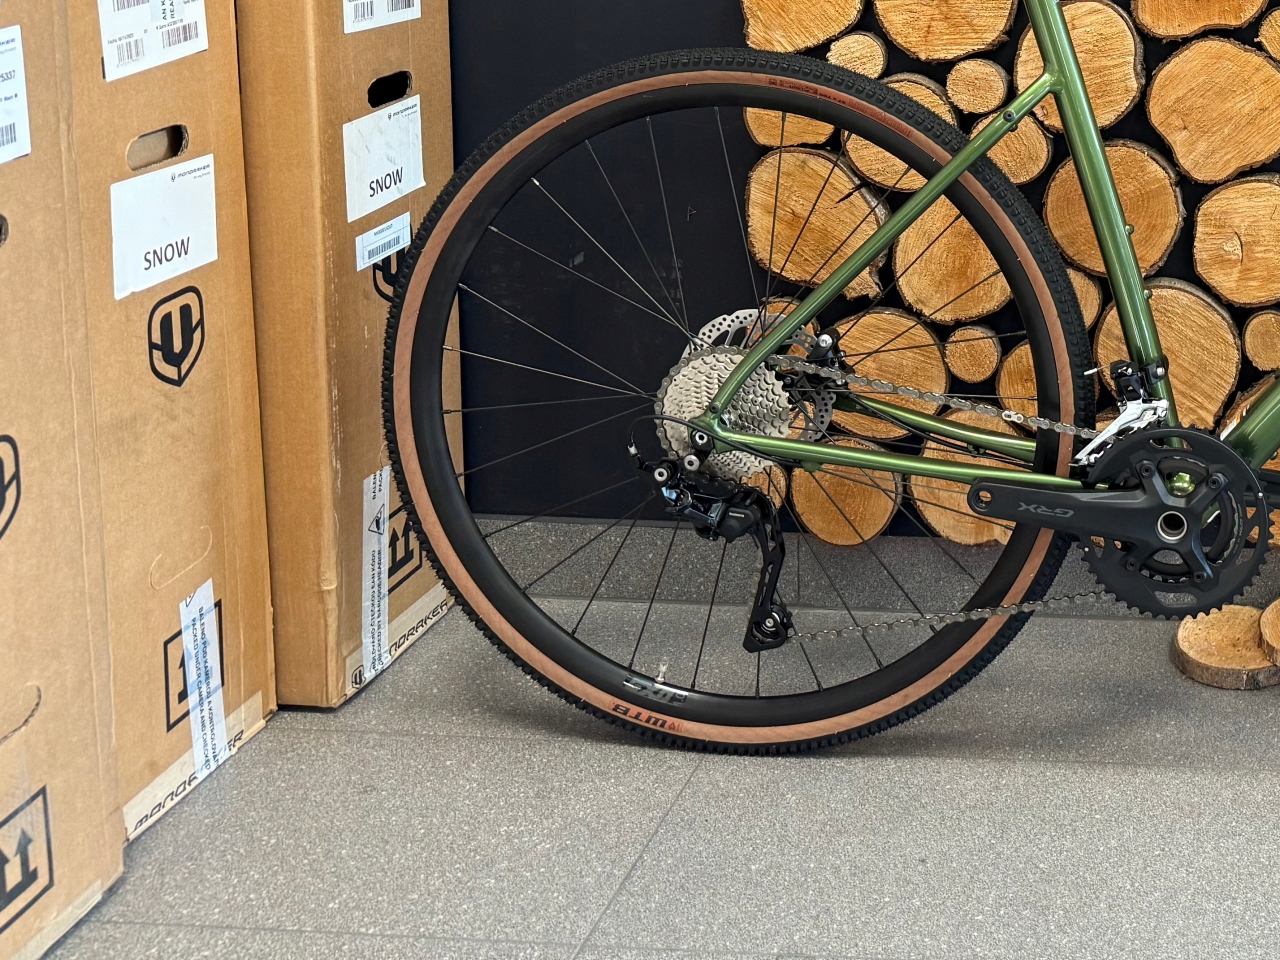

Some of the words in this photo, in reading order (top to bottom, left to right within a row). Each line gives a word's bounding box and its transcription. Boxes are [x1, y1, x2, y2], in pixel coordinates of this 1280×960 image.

[369, 167, 403, 197] SNOW
[144, 236, 190, 271] SNOW
[1017, 501, 1075, 518] GRX
[191, 617, 200, 651] PACKED
[194, 652, 202, 679] UNDER
[196, 680, 205, 715] CAMERA
[612, 704, 667, 729] WTB
